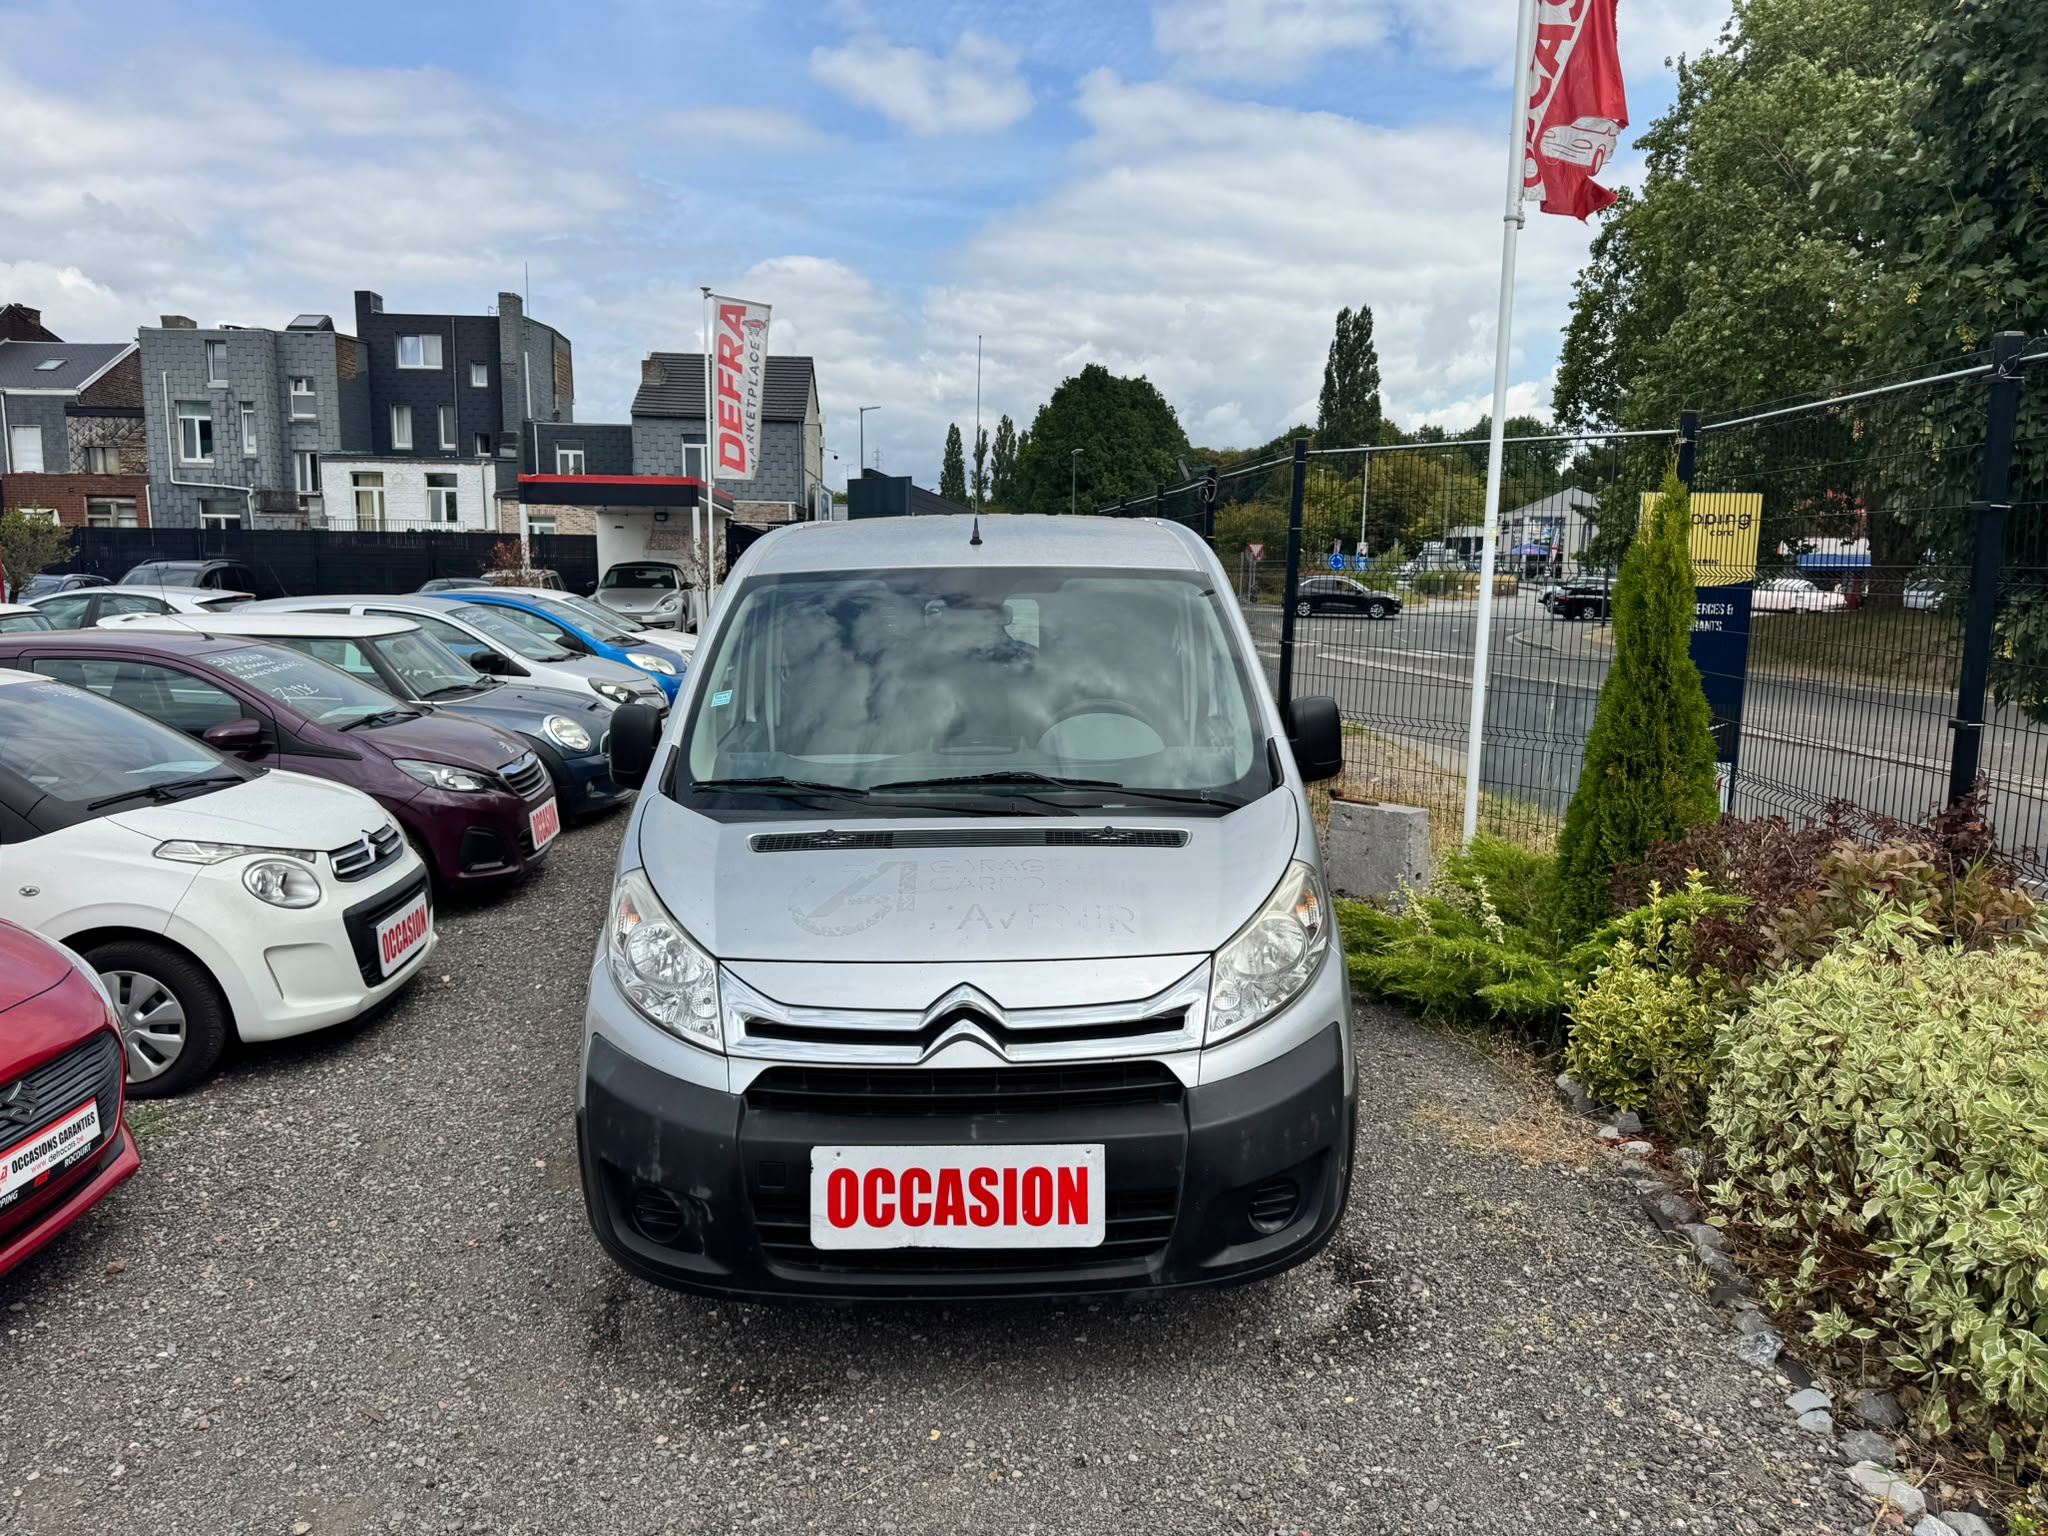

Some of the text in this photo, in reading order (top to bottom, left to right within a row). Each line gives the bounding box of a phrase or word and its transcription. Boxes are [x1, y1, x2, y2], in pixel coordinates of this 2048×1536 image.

[718, 303, 747, 473] DEFRA
[746, 341, 761, 471] MARKETPLACE
[1694, 603, 1725, 616] ERCES
[382, 904, 427, 964] OCCASION
[11, 1135, 58, 1174] OCCASIONS
[58, 1111, 96, 1145] GARANTIES
[64, 1142, 92, 1168] ROCOURT
[827, 1166, 1089, 1229] OCCASION
